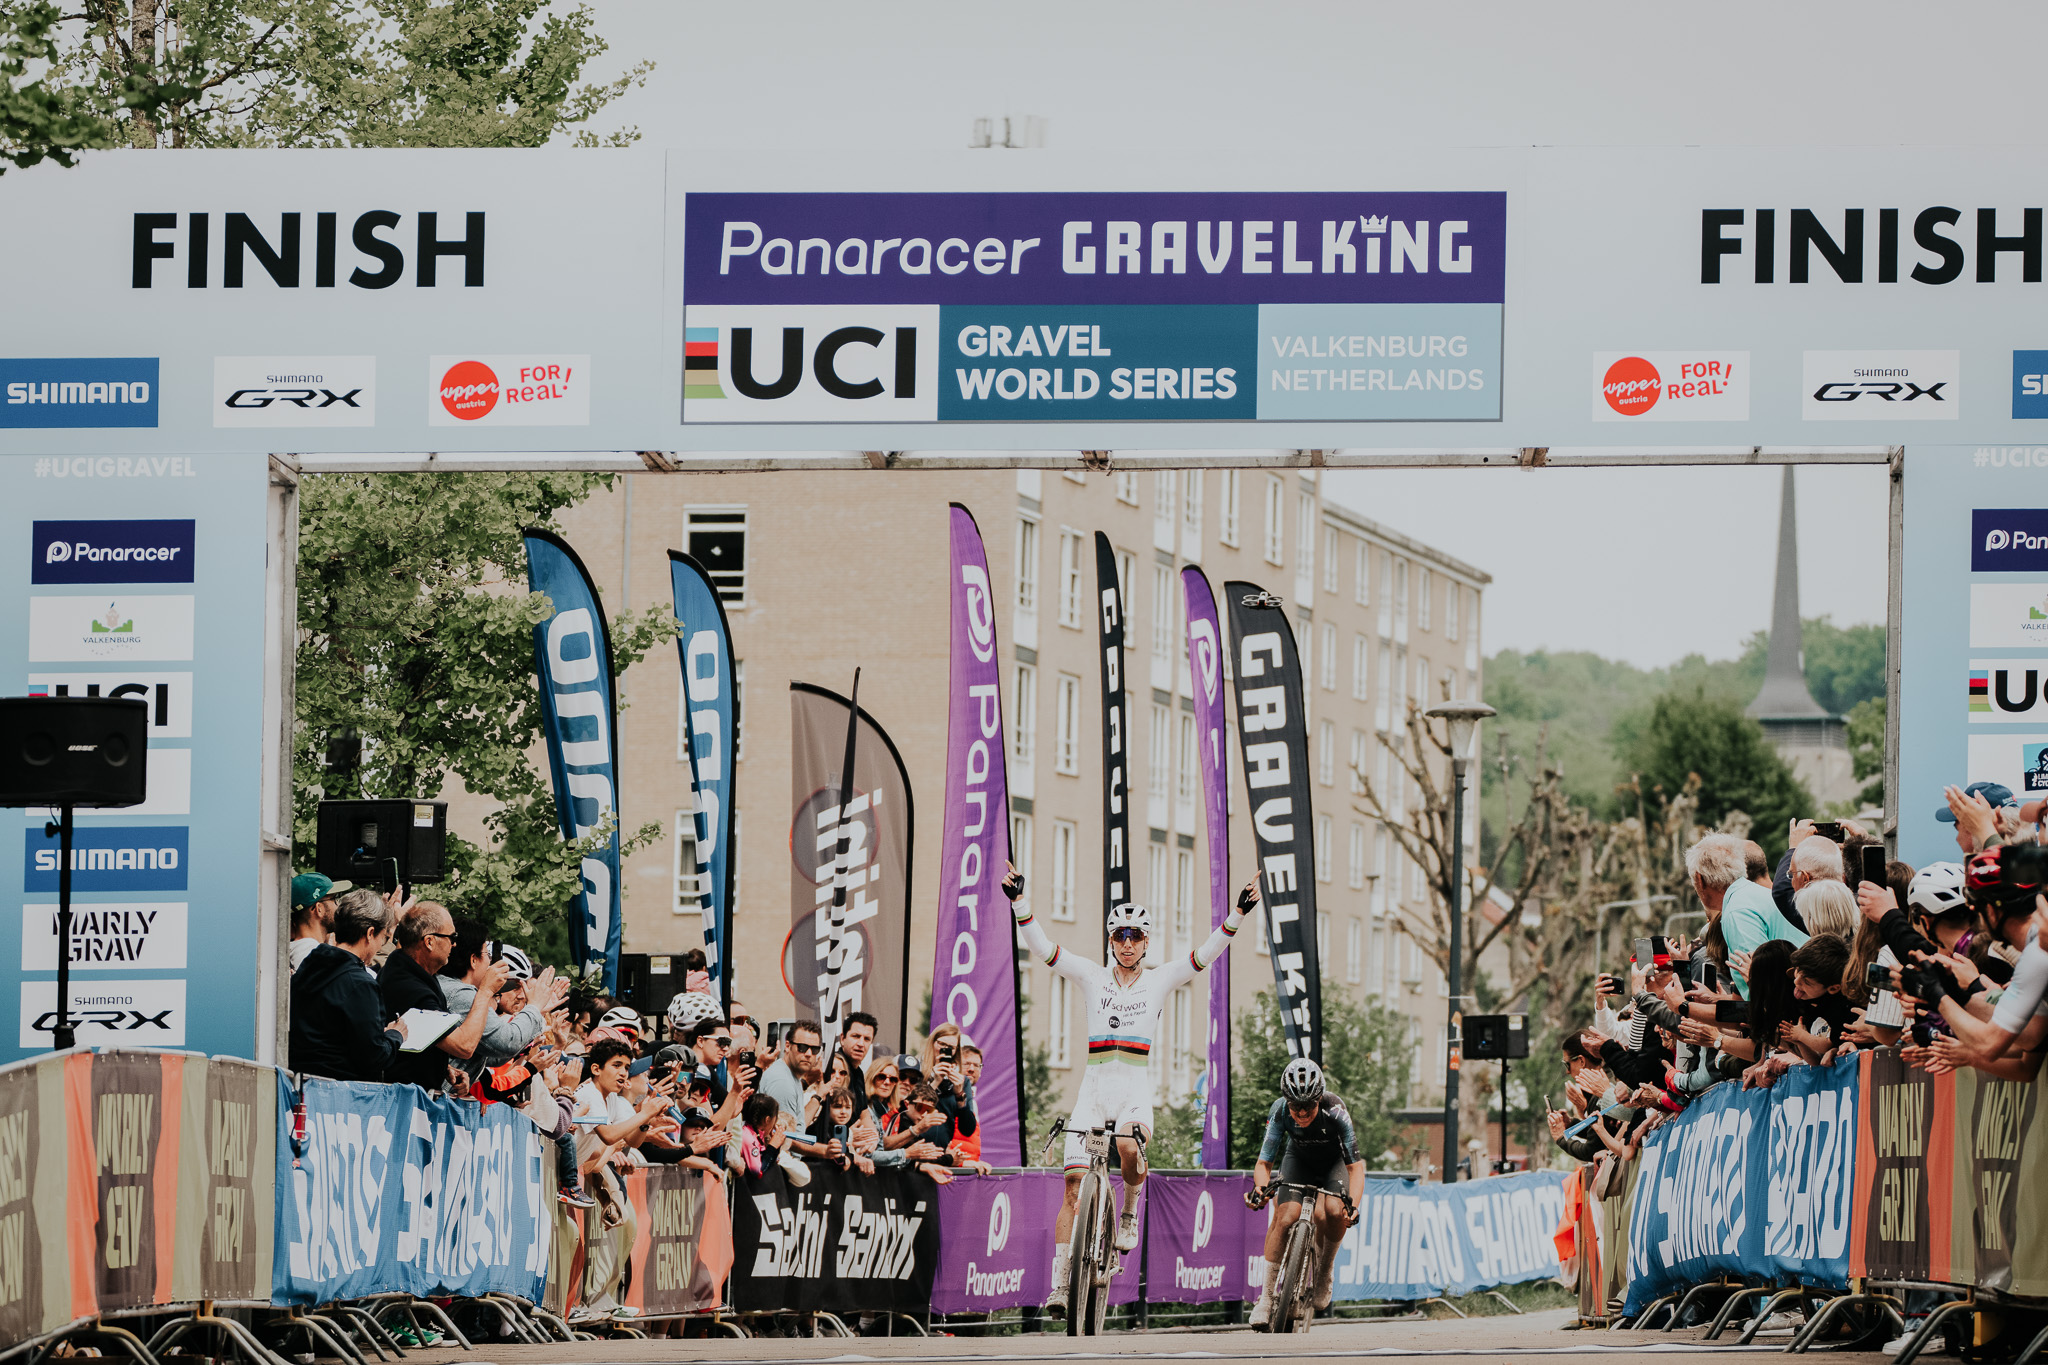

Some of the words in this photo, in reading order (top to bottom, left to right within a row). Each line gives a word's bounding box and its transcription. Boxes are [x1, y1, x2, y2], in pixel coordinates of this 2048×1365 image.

[132, 210, 485, 289] FINISH
[720, 221, 1040, 275] Panaracer
[1062, 214, 1472, 274] GRAVELKING
[1701, 206, 2043, 285] FINISH
[957, 325, 1111, 357] GRAVEL
[1272, 335, 1468, 358] VALKENBURG
[730, 326, 917, 400] UCI
[1681, 361, 1720, 379] FOR
[1853, 368, 1909, 377] SHIMANO
[266, 375, 323, 383] SHIMANO
[520, 365, 560, 383] FOR
[956, 368, 1100, 400] WORLD
[1108, 367, 1237, 400] SERIES
[1271, 369, 1484, 392] NETHERLANDS
[7, 381, 149, 405] SHIMANO
[440, 382, 499, 401] upper
[1603, 378, 1661, 397] upper
[1813, 382, 1948, 401] GRX
[225, 389, 363, 408] GRX
[456, 399, 486, 409] austria
[1619, 395, 1648, 405] austria
[34, 457, 196, 478] #UCIGRAVEL
[75, 543, 180, 561] Panaracer
[946, 684, 1000, 1046] Panarac
[75, 997, 133, 1005] SHIMANO
[32, 1010, 173, 1031] GRX
[656, 1242, 691, 1290] GRAV
[1176, 1256, 1225, 1291] Panaracer
[966, 1262, 1025, 1296] Panaracer
